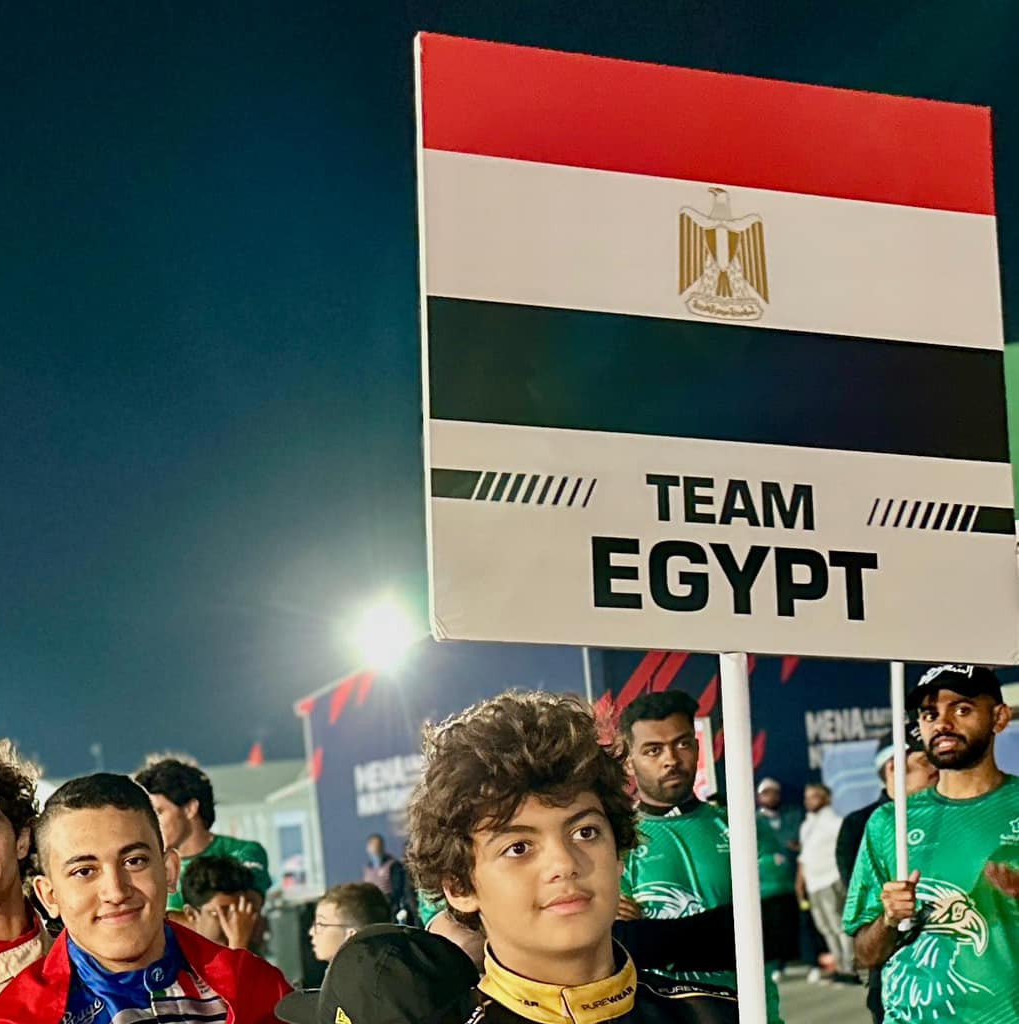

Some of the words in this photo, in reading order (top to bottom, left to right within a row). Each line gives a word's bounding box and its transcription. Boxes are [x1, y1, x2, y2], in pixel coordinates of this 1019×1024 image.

[646, 473, 815, 530] TEAM
[591, 536, 878, 621] EGYPT
[805, 708, 867, 742] MENA
[581, 985, 635, 1011] PUREWEAR
